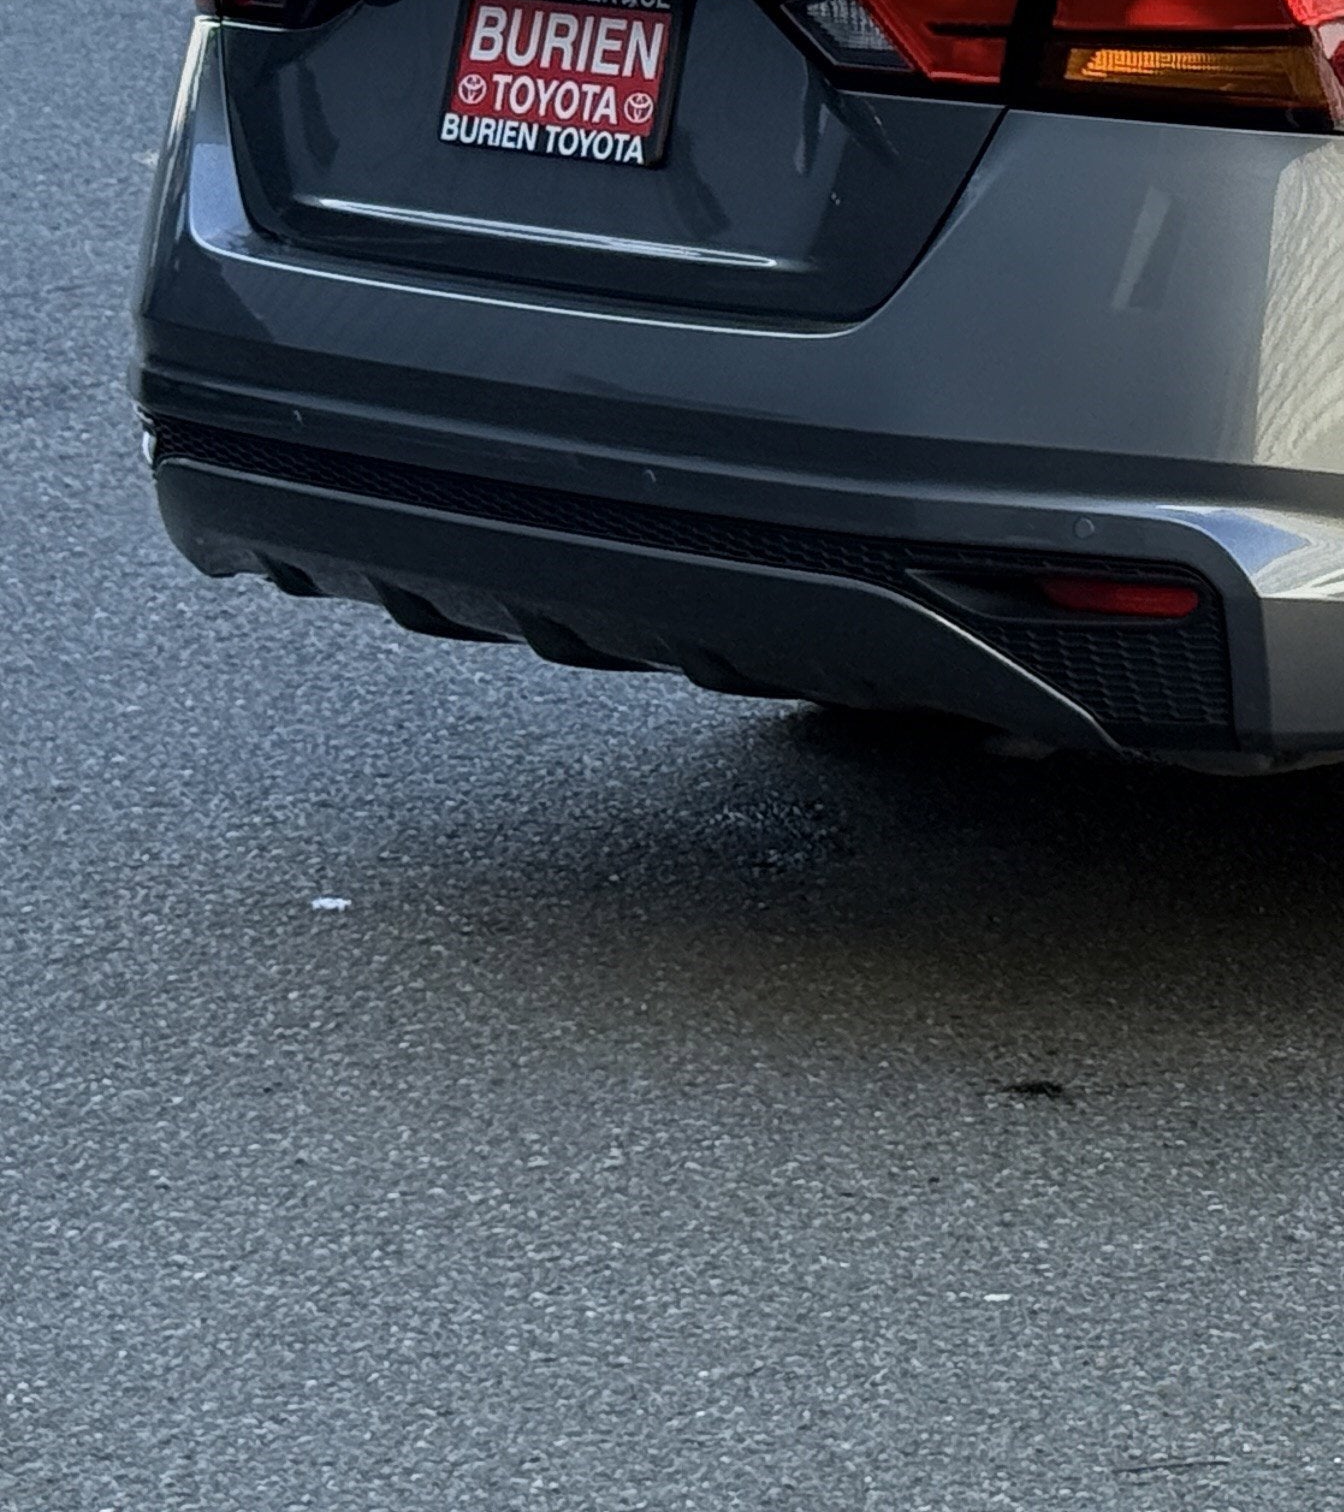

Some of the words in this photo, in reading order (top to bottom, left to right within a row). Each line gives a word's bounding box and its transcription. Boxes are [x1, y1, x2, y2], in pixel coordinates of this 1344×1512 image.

[469, 5, 664, 80] BURIEN
[492, 74, 618, 125] TOYOTA
[440, 112, 539, 152] BURIEN
[546, 125, 645, 165] TOYOTA
